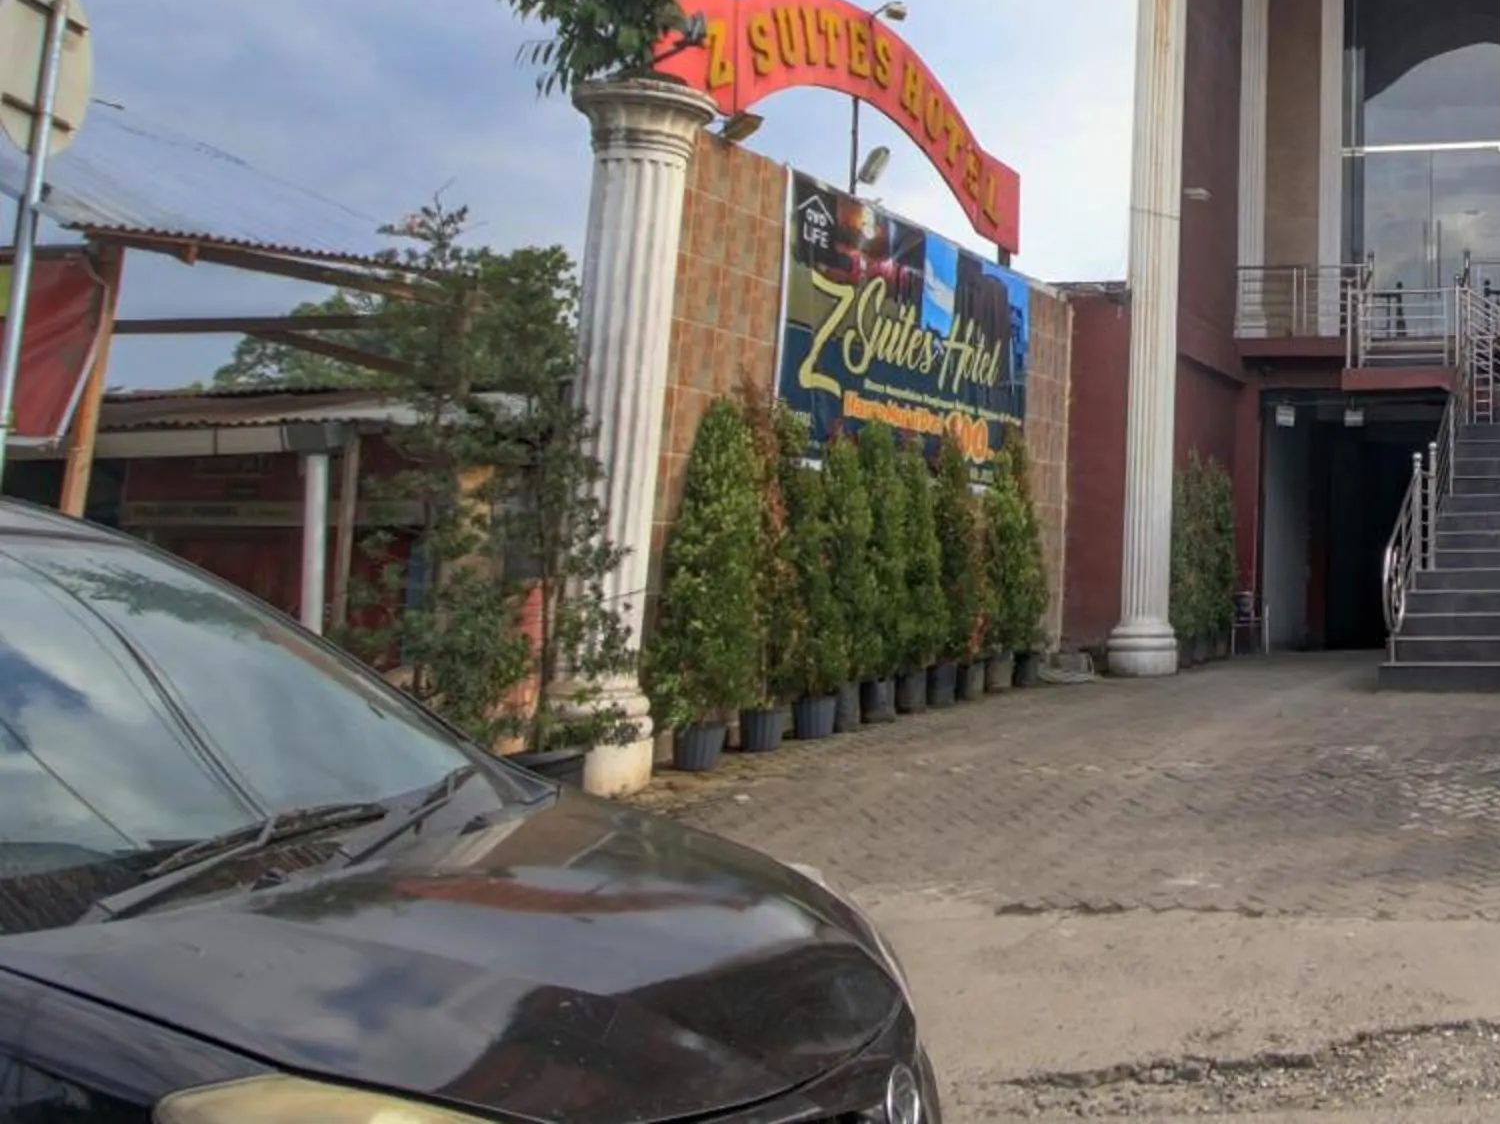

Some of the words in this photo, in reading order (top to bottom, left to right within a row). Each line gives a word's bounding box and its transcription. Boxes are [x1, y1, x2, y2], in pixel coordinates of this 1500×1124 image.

[706, 17, 732, 90] Z
[748, 6, 893, 90] SUITES
[899, 59, 1000, 230] HOTEL
[803, 222, 830, 249] LIFE
[798, 269, 855, 398] Z
[842, 275, 934, 374] Suites
[937, 313, 1003, 394] Hotel
